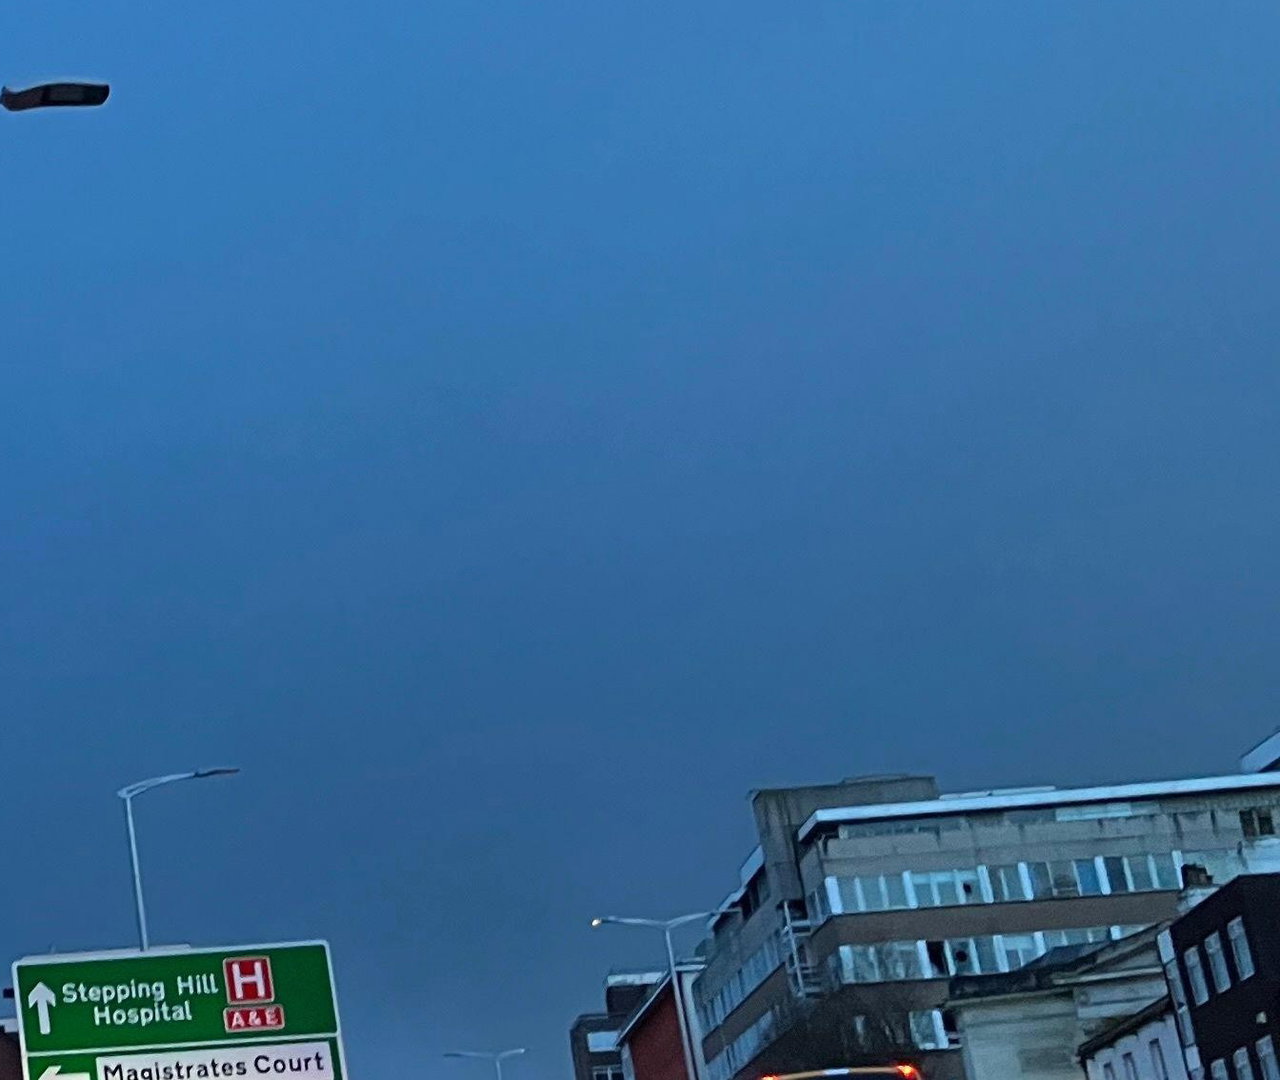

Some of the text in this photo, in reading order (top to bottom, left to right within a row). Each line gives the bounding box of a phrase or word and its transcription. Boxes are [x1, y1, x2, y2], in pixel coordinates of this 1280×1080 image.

[61, 973, 219, 1004] Stepping Hill
[230, 961, 267, 1000] H
[93, 1000, 193, 1027] Hospital
[230, 1007, 279, 1028] A&E
[102, 1051, 325, 1080] Magistrates Court
